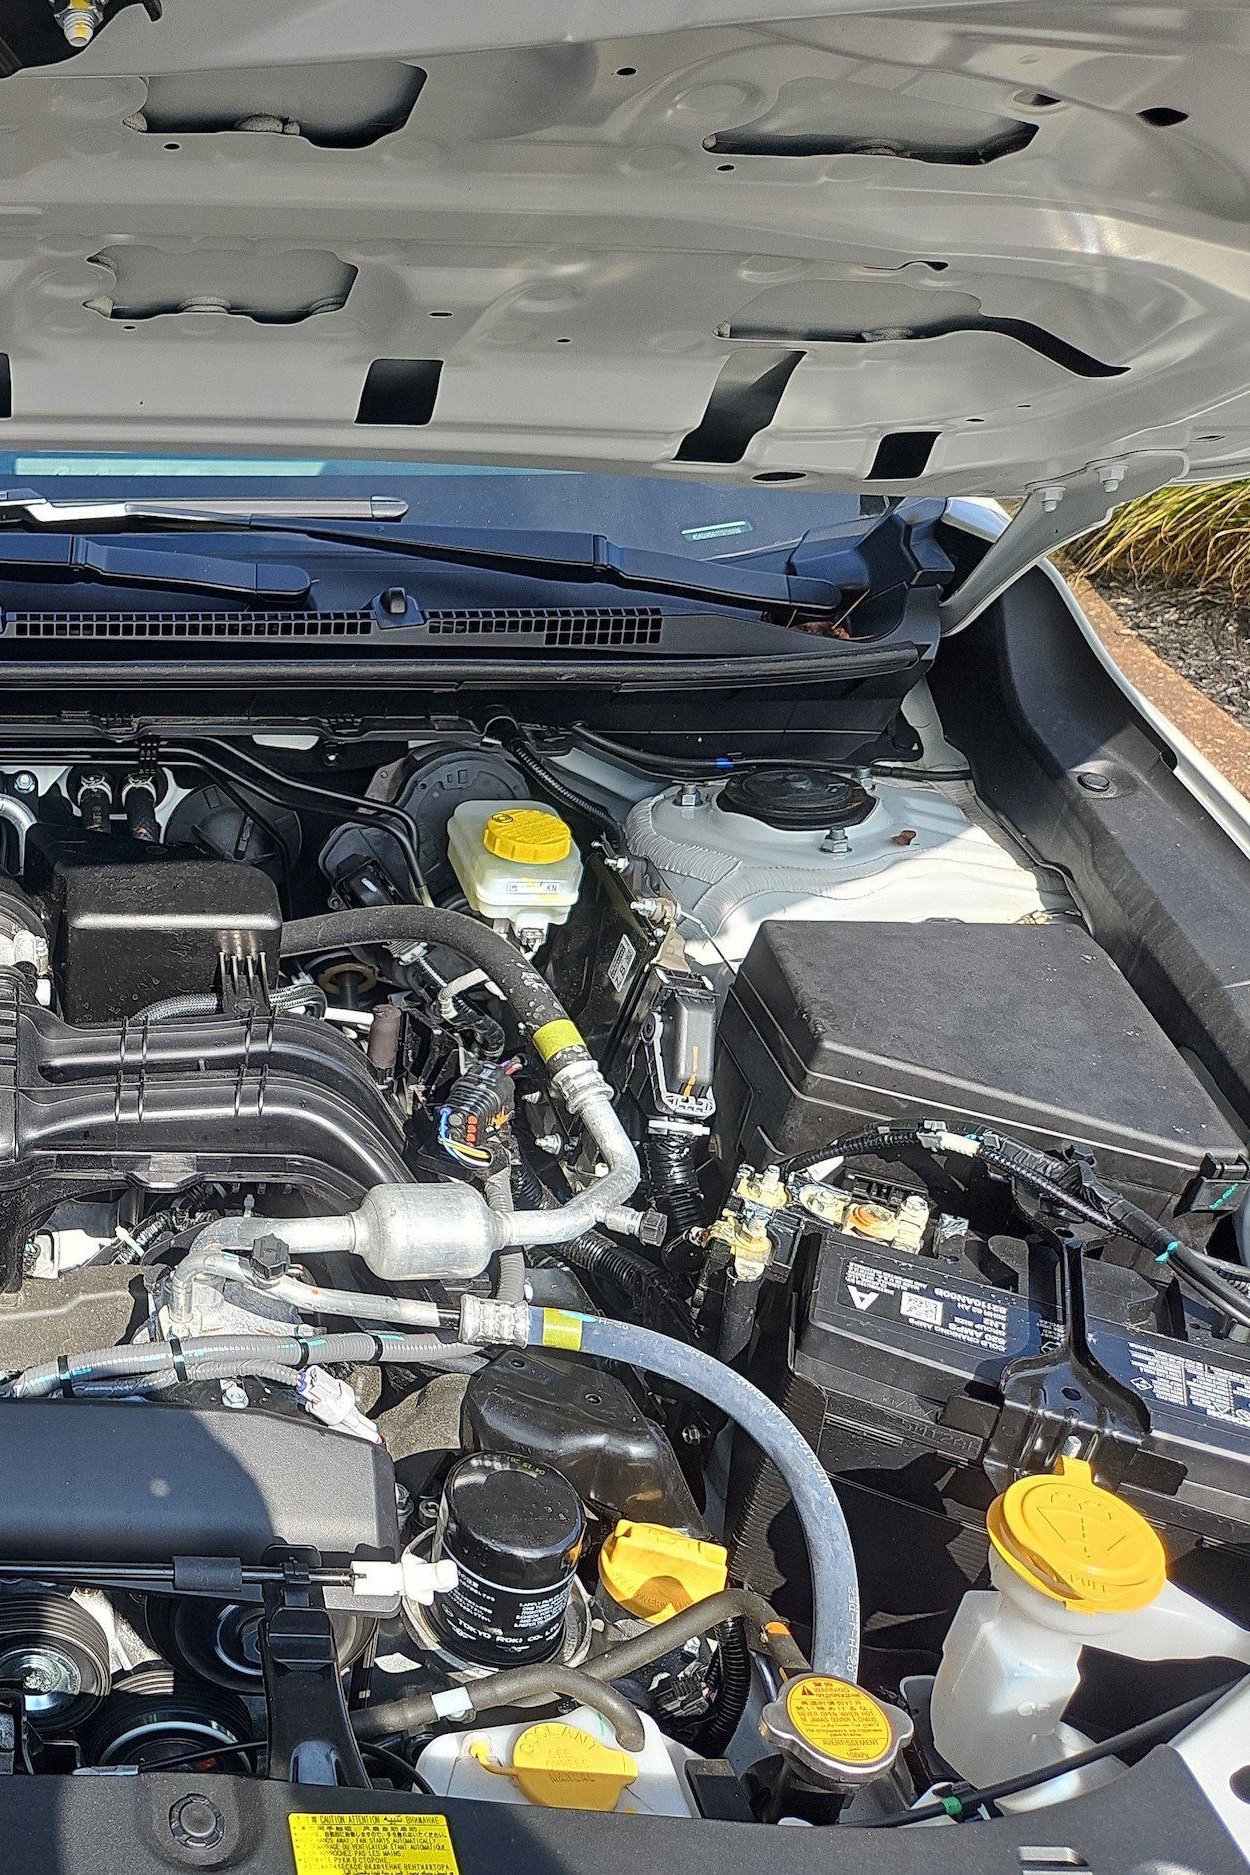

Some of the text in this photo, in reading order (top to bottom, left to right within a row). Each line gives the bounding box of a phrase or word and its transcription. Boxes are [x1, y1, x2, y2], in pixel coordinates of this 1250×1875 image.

[908, 1317, 934, 1331] AMPS
[948, 1322, 985, 1338] AMPS
[457, 1618, 492, 1640] TOKYO
[496, 1636, 523, 1644] ROKI
[519, 1725, 600, 1755] COOLANT
[319, 1815, 346, 1824] CAUTION
[348, 1815, 380, 1824] ATTENTION
[405, 1815, 440, 1825] ВНИМАНИЕ
